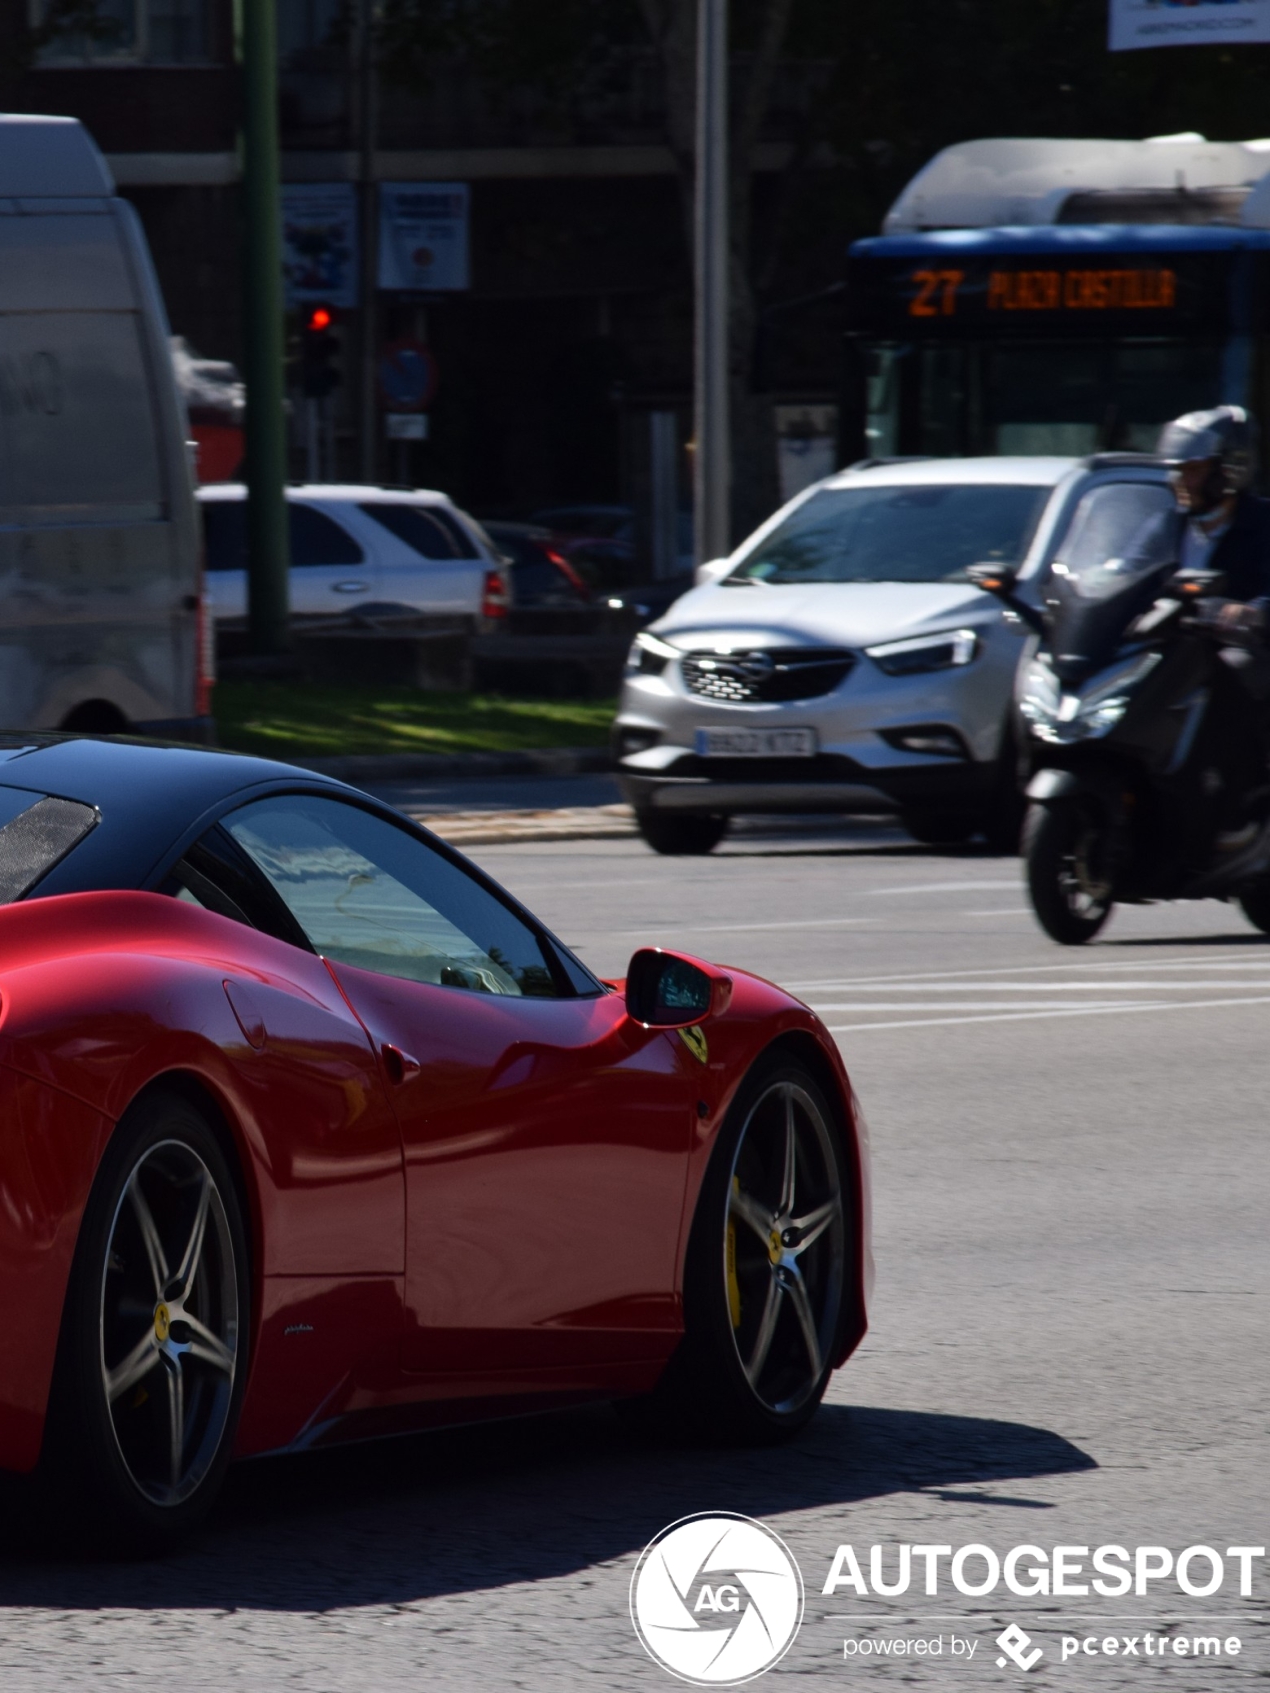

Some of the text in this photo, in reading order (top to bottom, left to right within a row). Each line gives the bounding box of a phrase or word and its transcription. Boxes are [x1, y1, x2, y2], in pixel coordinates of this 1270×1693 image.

[908, 268, 1176, 317] 27 PLAZA CASTILLA
